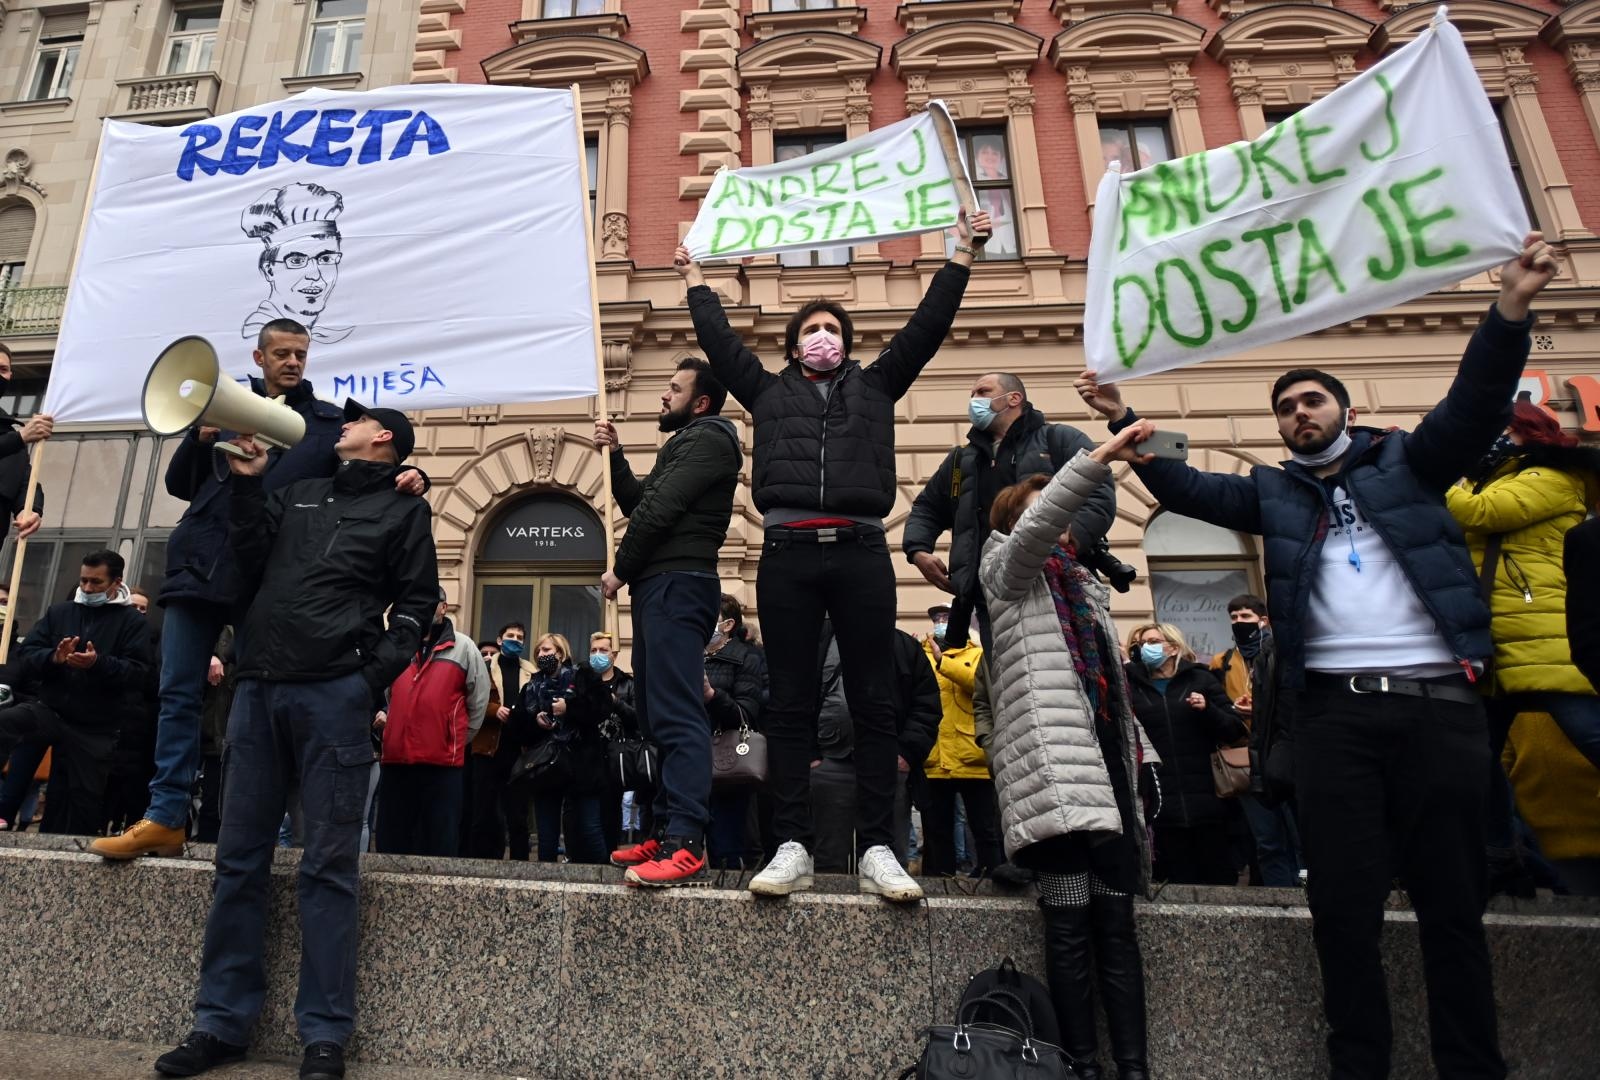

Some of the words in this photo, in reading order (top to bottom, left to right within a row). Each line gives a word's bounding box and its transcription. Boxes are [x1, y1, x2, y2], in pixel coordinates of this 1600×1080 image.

[176, 108, 451, 182] REKETA
[711, 127, 927, 209] ANDREJ
[709, 200, 878, 255] DOSTA
[892, 177, 957, 231] JE
[1112, 218, 1347, 369] DOSTA
[1360, 167, 1471, 282] JE
